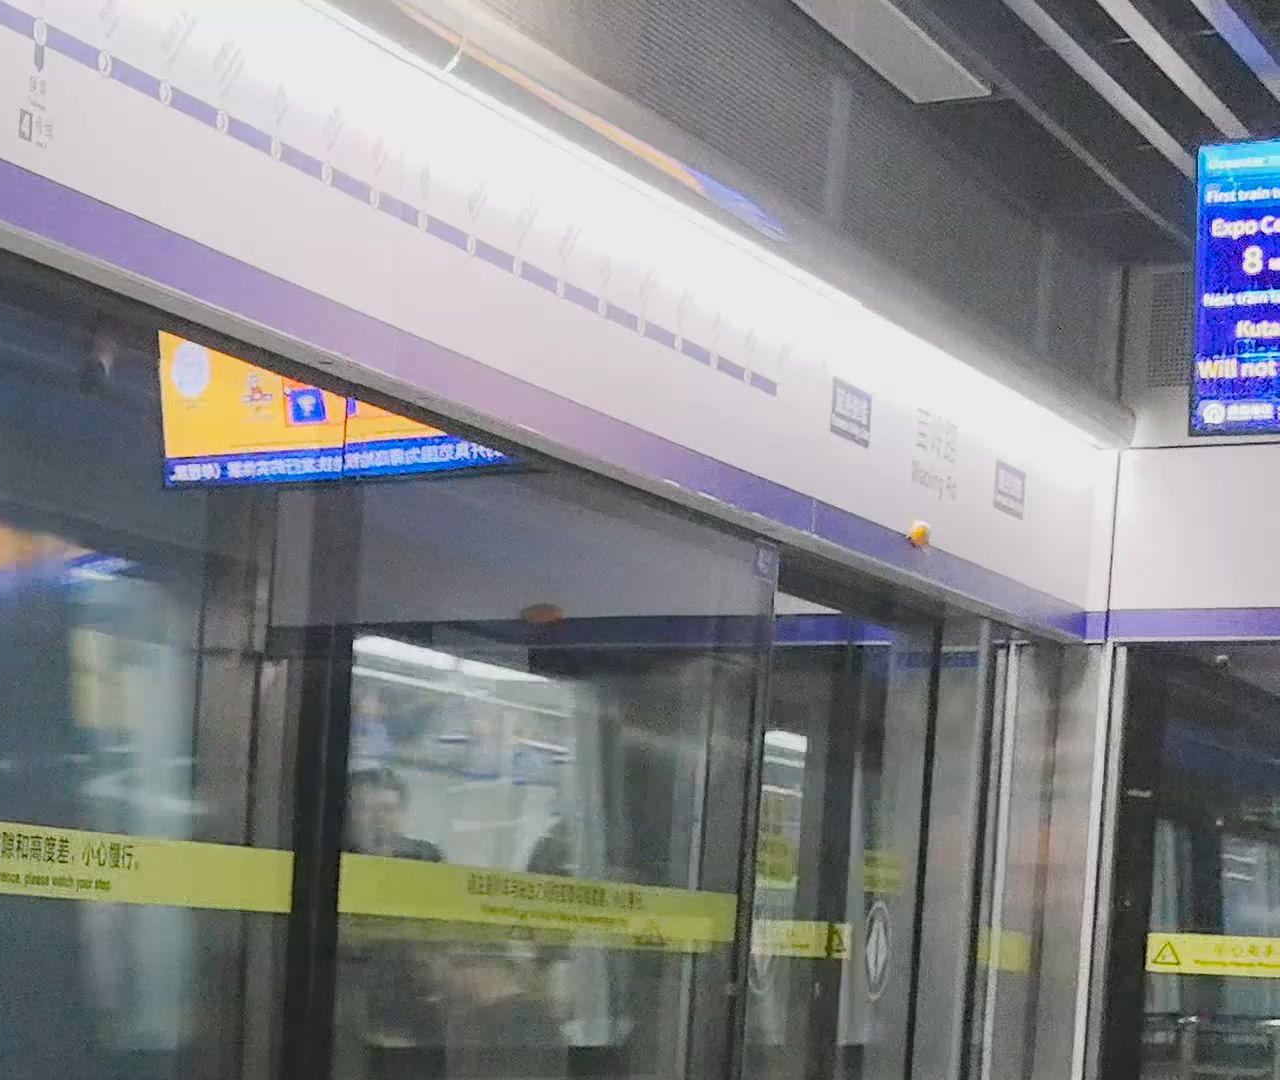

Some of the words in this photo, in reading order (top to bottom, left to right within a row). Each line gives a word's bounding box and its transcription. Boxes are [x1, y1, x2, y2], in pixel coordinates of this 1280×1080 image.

[1211, 218, 1258, 240] Expo
[1242, 245, 1263, 275] 8
[1197, 357, 1237, 378] Will
[1240, 359, 1277, 378] not
